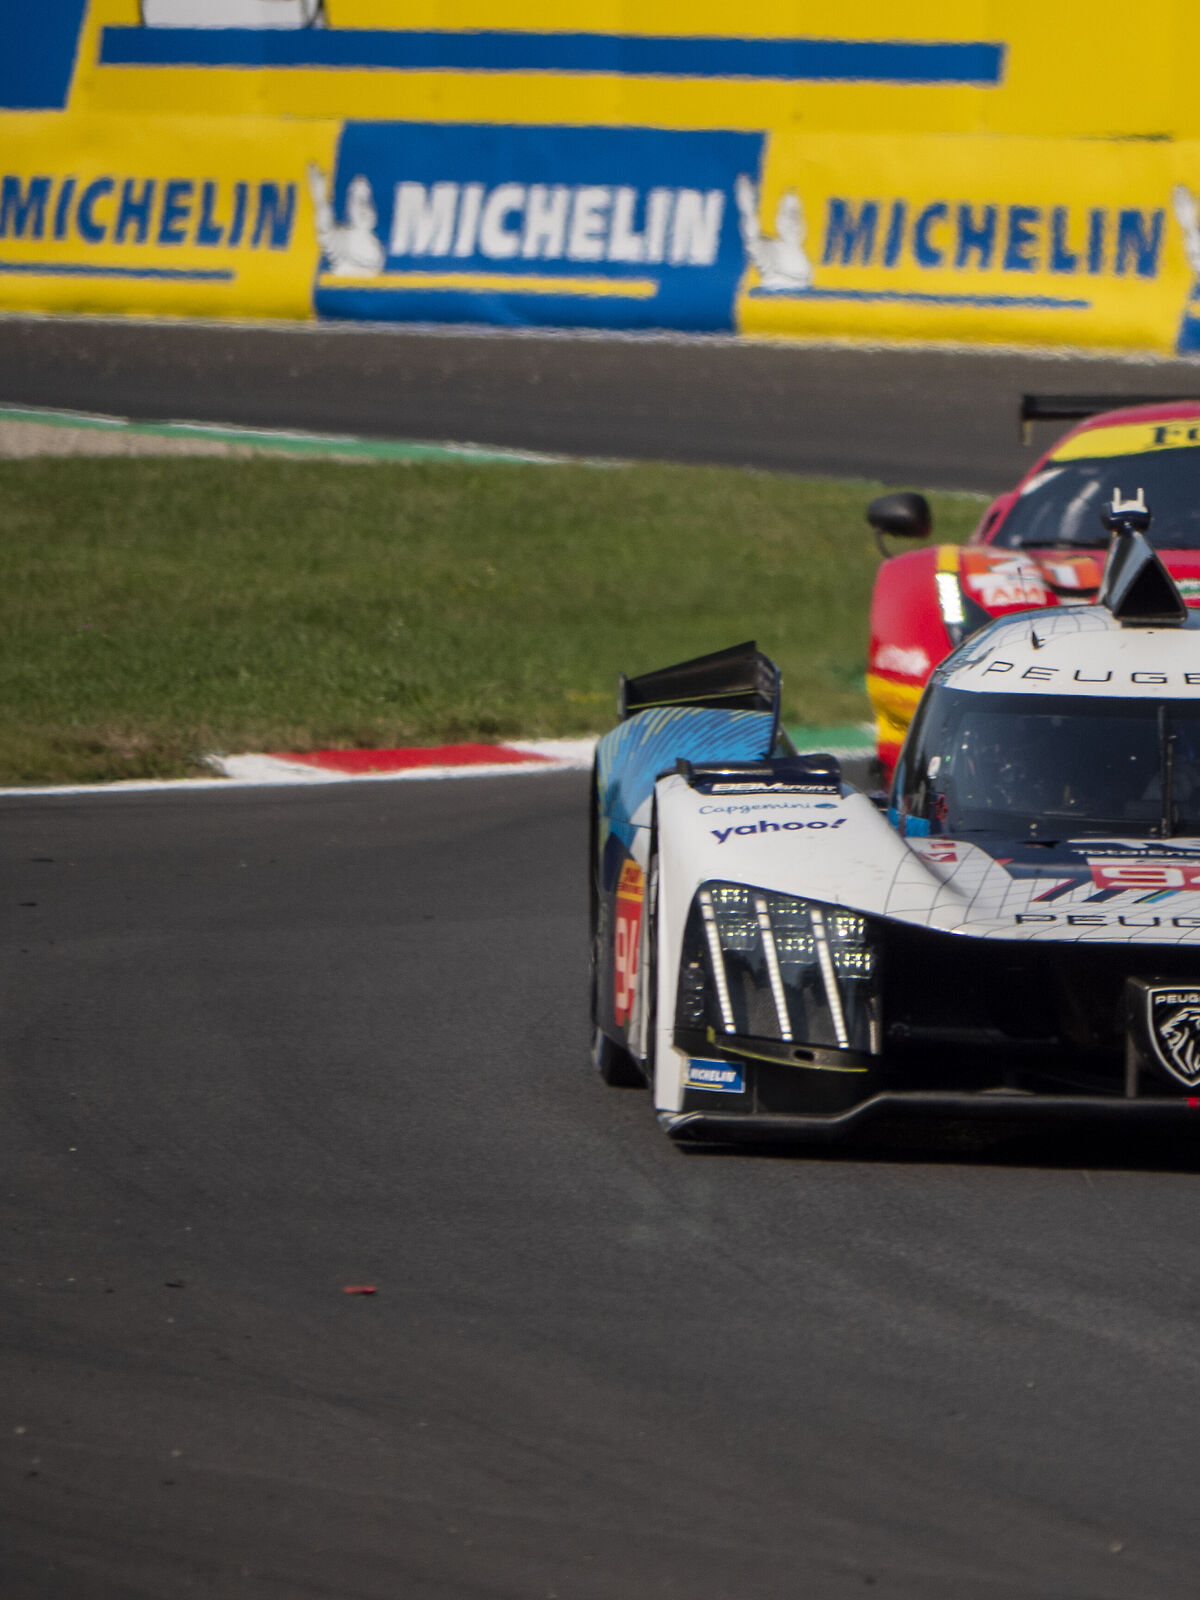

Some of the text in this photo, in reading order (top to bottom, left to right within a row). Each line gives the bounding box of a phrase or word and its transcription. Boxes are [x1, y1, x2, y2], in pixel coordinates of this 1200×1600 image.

[0, 174, 297, 250] MICHELIN
[389, 180, 725, 266] MICHELIN
[821, 197, 1165, 279] MICHELIN
[698, 802, 811, 815] Capgemini
[710, 818, 848, 844] yahoo!
